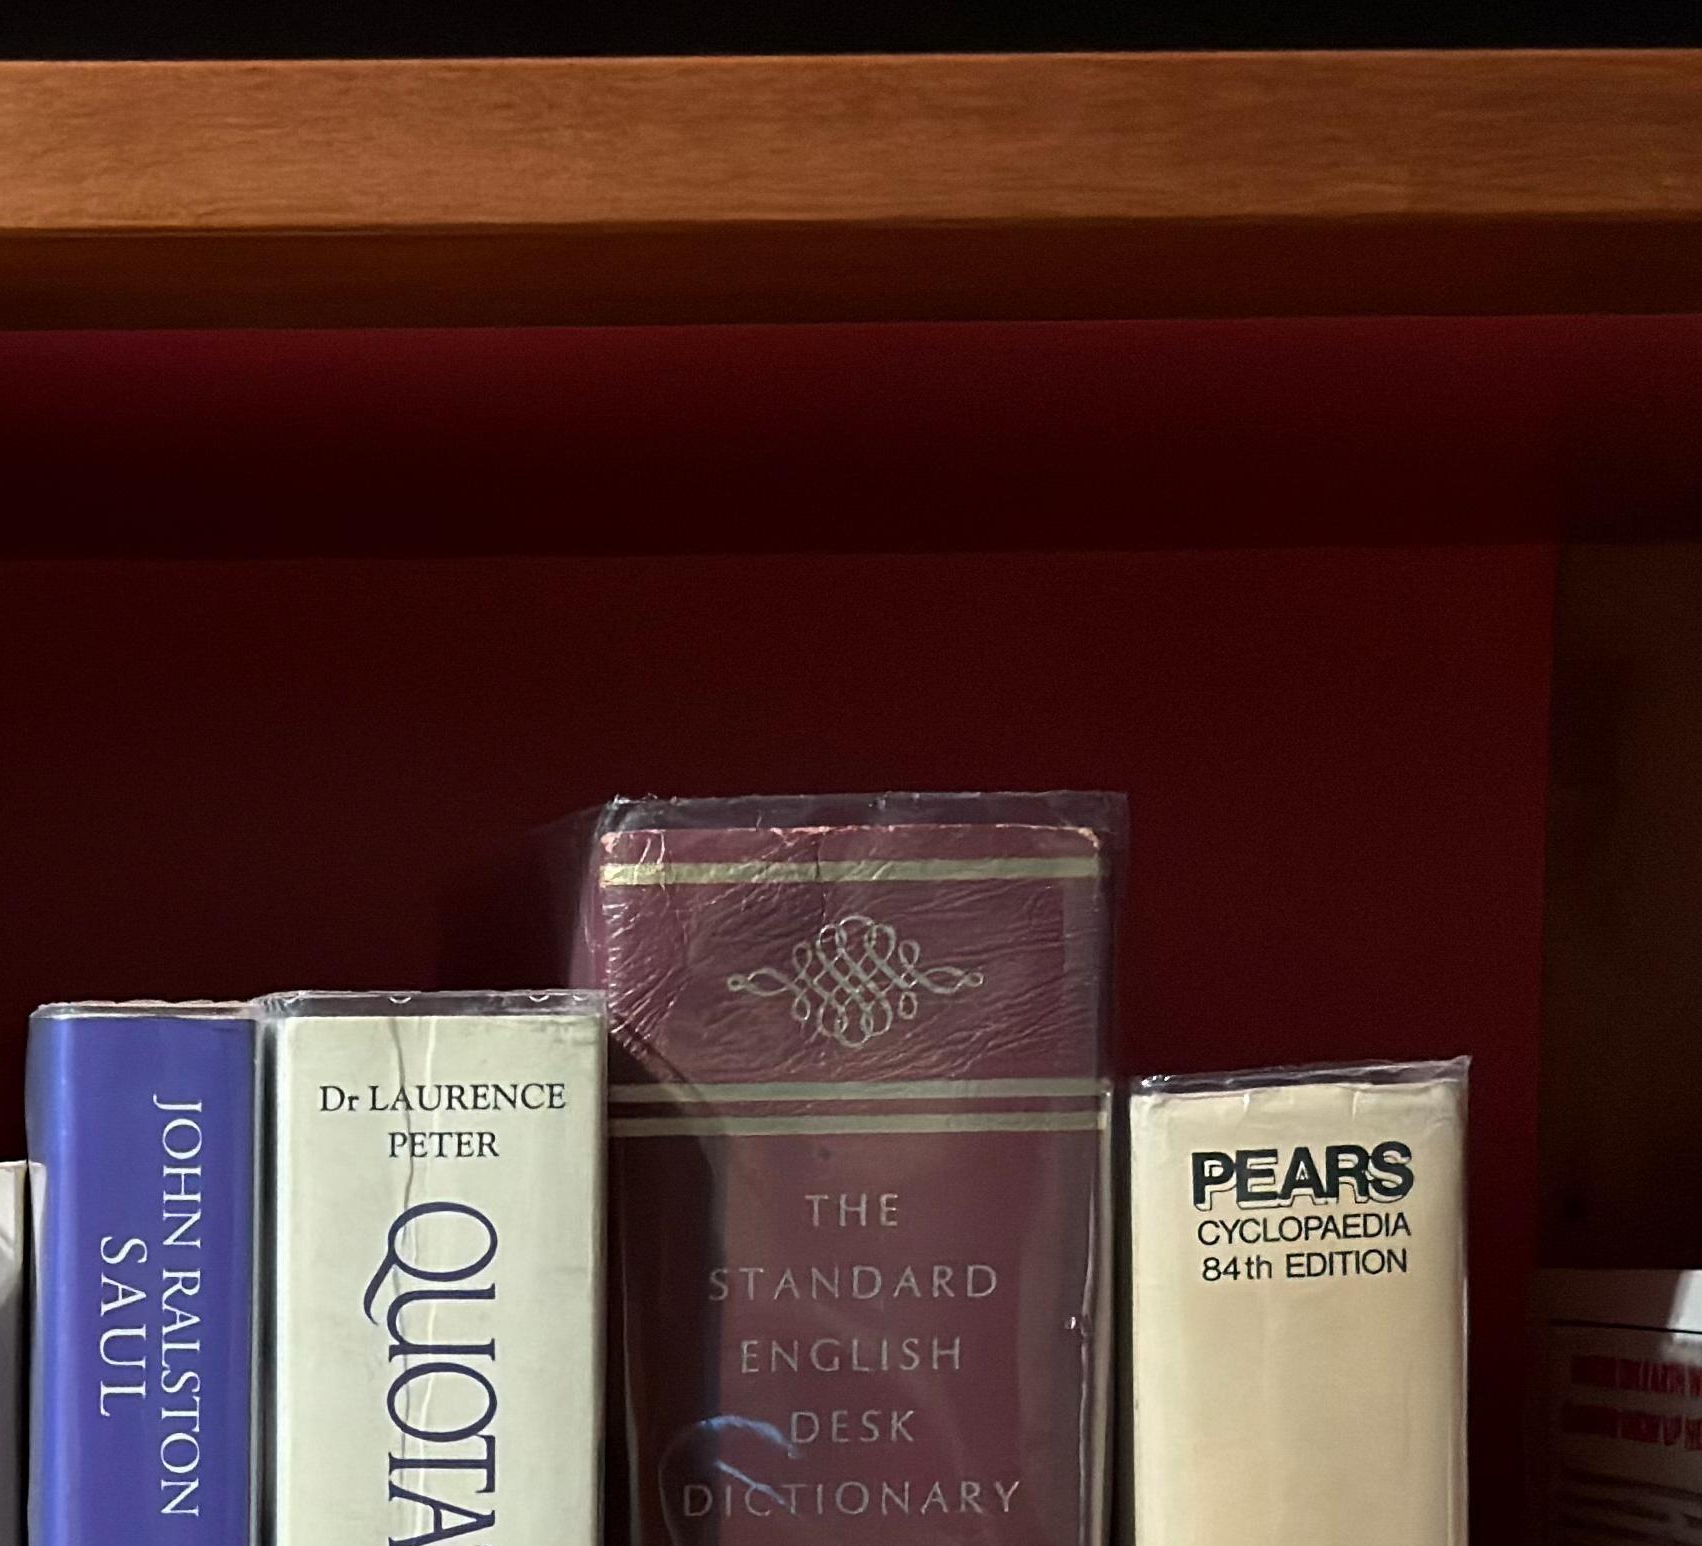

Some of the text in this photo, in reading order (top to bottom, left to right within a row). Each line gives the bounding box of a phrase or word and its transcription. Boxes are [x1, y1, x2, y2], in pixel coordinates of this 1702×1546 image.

[319, 1083, 567, 1112] Dr LAURENCE
[387, 1130, 499, 1158] PETER
[1191, 1140, 1414, 1211] PEARS
[805, 1193, 899, 1228] THE
[1197, 1212, 1411, 1245] CYCLOPAEDIA
[1202, 1248, 1407, 1281] 84th EDITION
[709, 1264, 997, 1302] STANDARD
[153, 1095, 202, 1517] JOHN RALSTON
[99, 1236, 148, 1417] SAUL
[740, 1337, 961, 1374] ENGLISH
[790, 1410, 915, 1444] DESK
[683, 1480, 1020, 1517] DICTIONARY
